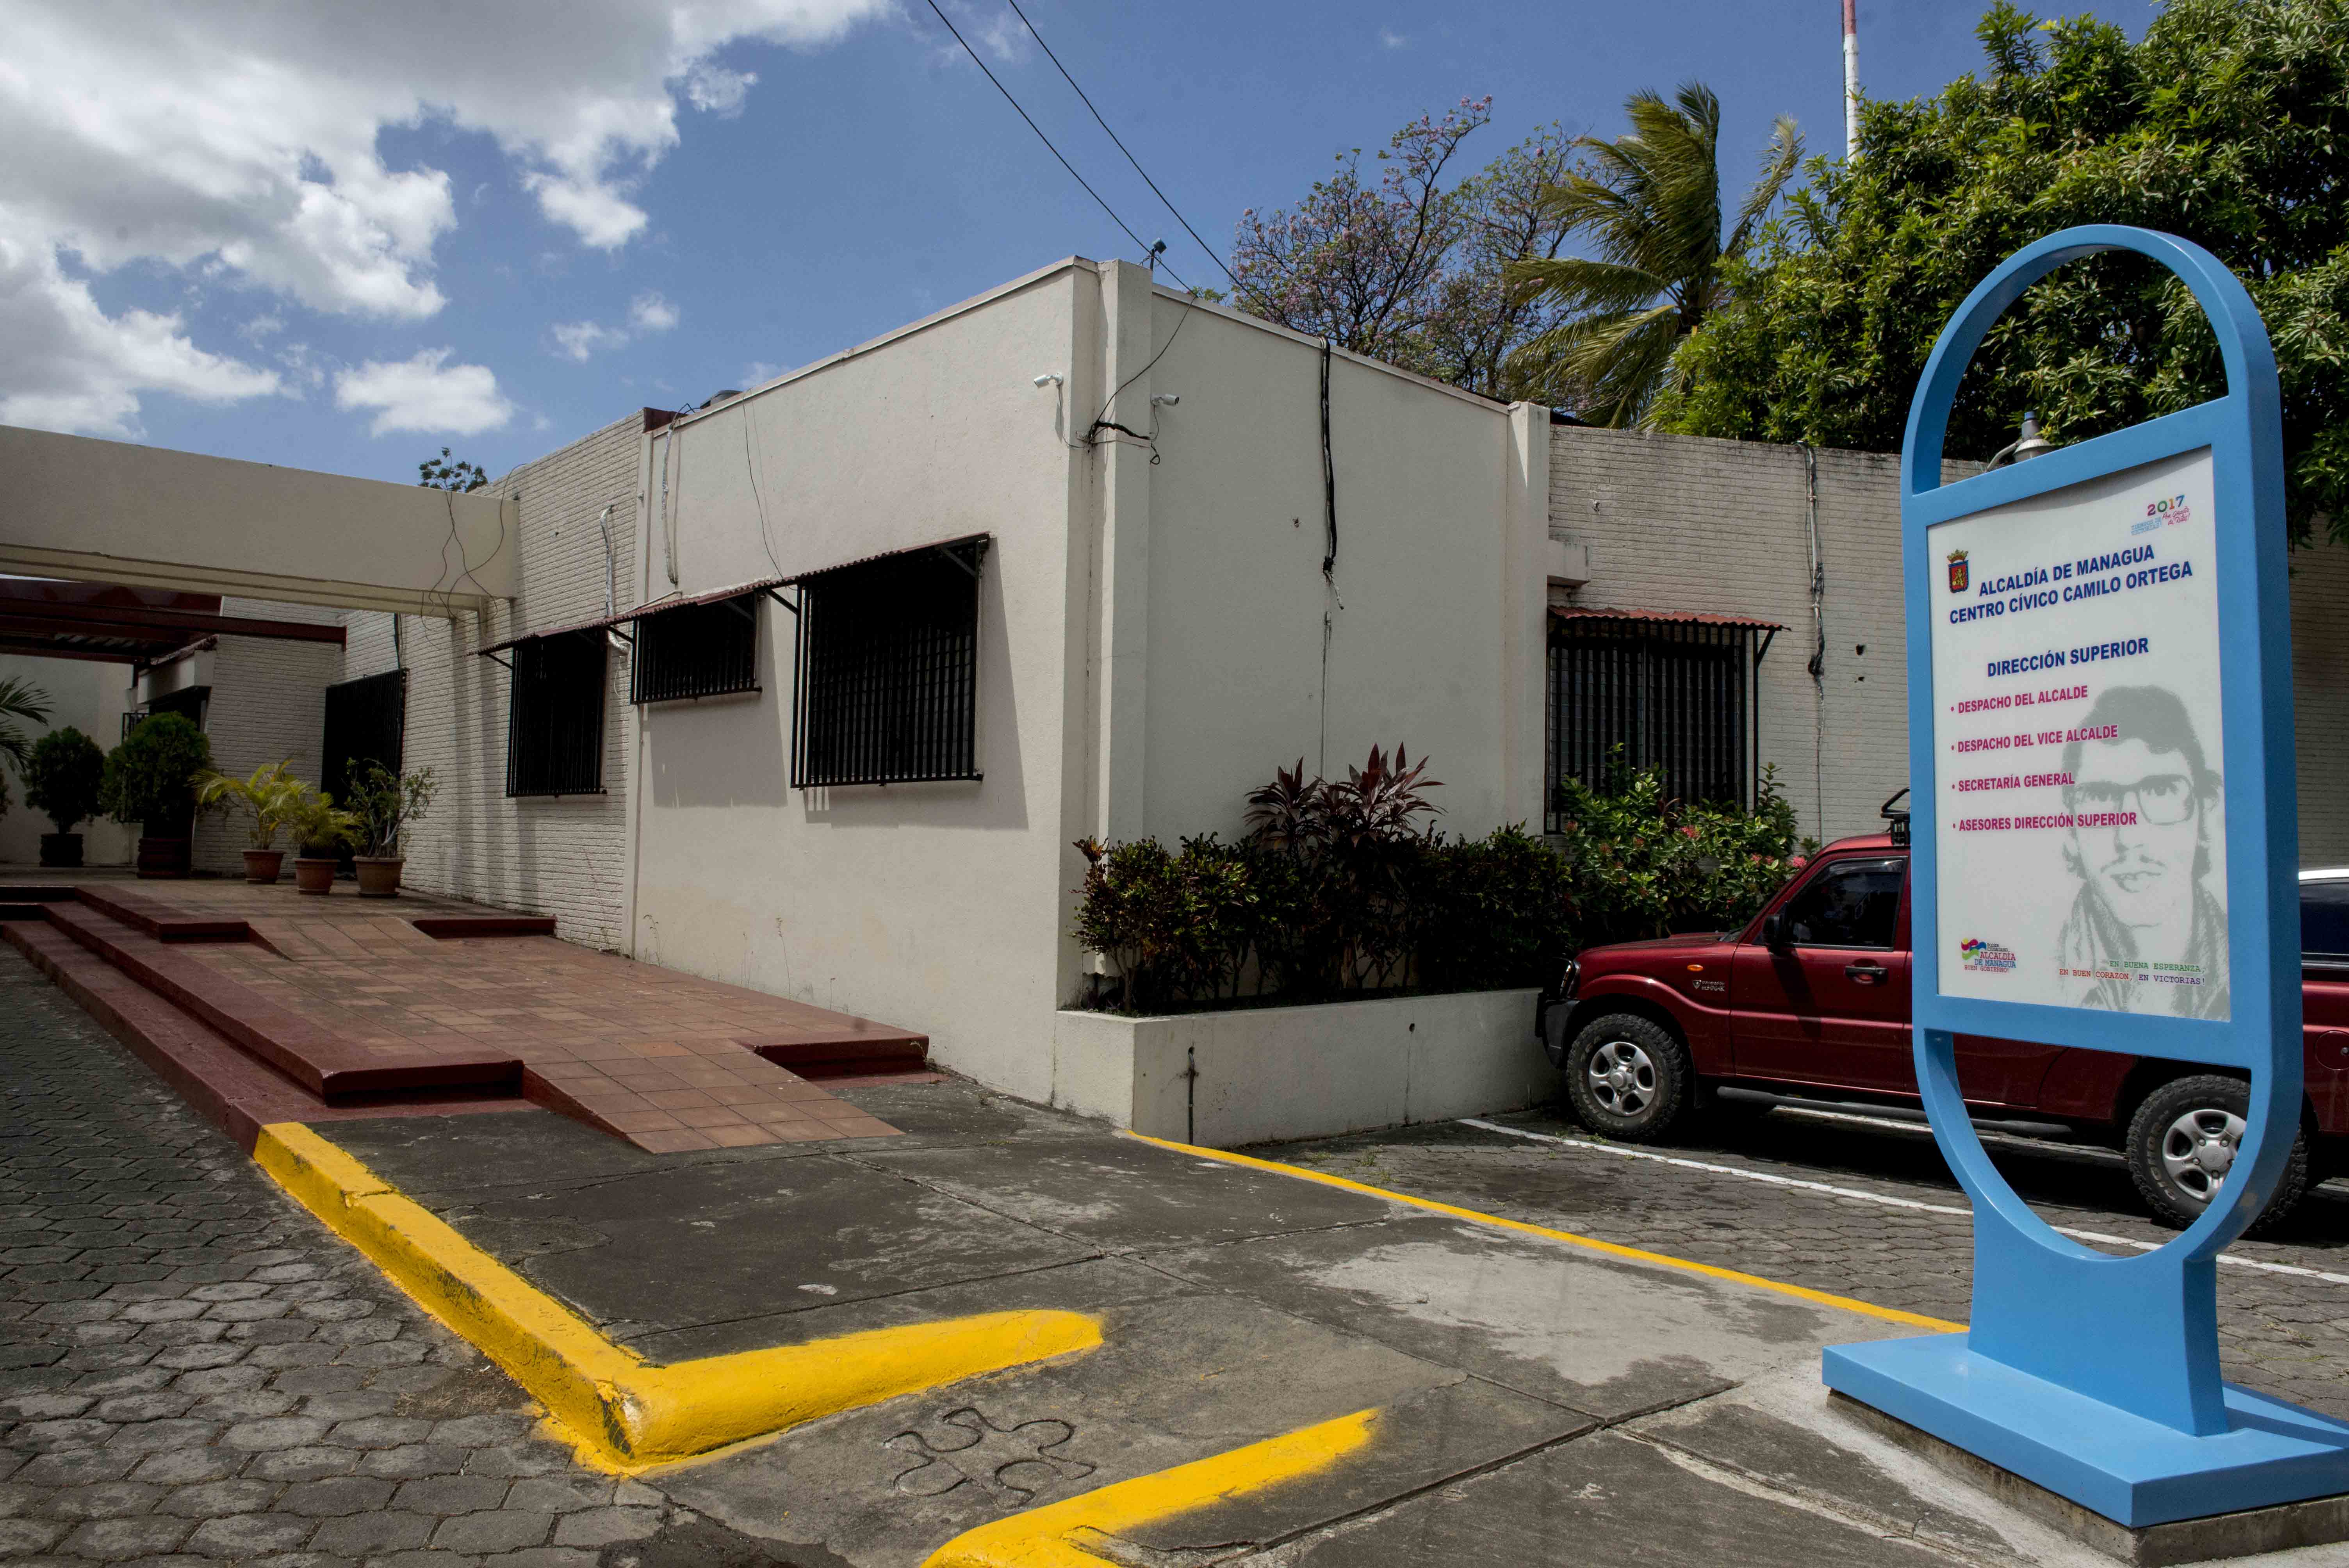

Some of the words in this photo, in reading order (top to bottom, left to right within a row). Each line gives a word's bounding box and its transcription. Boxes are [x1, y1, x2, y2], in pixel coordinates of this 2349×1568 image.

[2147, 494, 2185, 516] 2017
[1980, 567, 2049, 597] ALCALDÍA
[2053, 563, 2073, 581] DE
[2077, 545, 2156, 575] MANAGUA
[1949, 600, 2006, 624] CENTRO
[2010, 590, 2059, 613] CÍVICO
[2063, 576, 2122, 602] CAMILO
[2126, 562, 2193, 588] ORTEGA
[1988, 650, 2066, 677] DIRECCIÓN
[2071, 637, 2149, 665] SUPERIOR
[1958, 696, 2012, 714] DESPACHO
[2014, 693, 2034, 706] DEL
[2038, 685, 2087, 703] ALCALDE
[1958, 737, 2011, 753] DESPACHO
[2014, 734, 2035, 747] DEL
[2037, 731, 2062, 744] VICE
[2066, 725, 2118, 741] ALCALDE
[1959, 774, 2021, 792] SECRETARÍA
[2024, 773, 2074, 788] GENERAL
[1959, 818, 2011, 831] ASESORES
[2014, 812, 2074, 830] DIRECCIÓN
[2078, 812, 2137, 827] SUPERIOR
[1985, 960, 2017, 968] MANAGUA
[2153, 963, 2205, 973] ESPERANZA,
[2096, 971, 2132, 981] CORAZON,
[2153, 975, 2205, 985] VICTORIAS!
